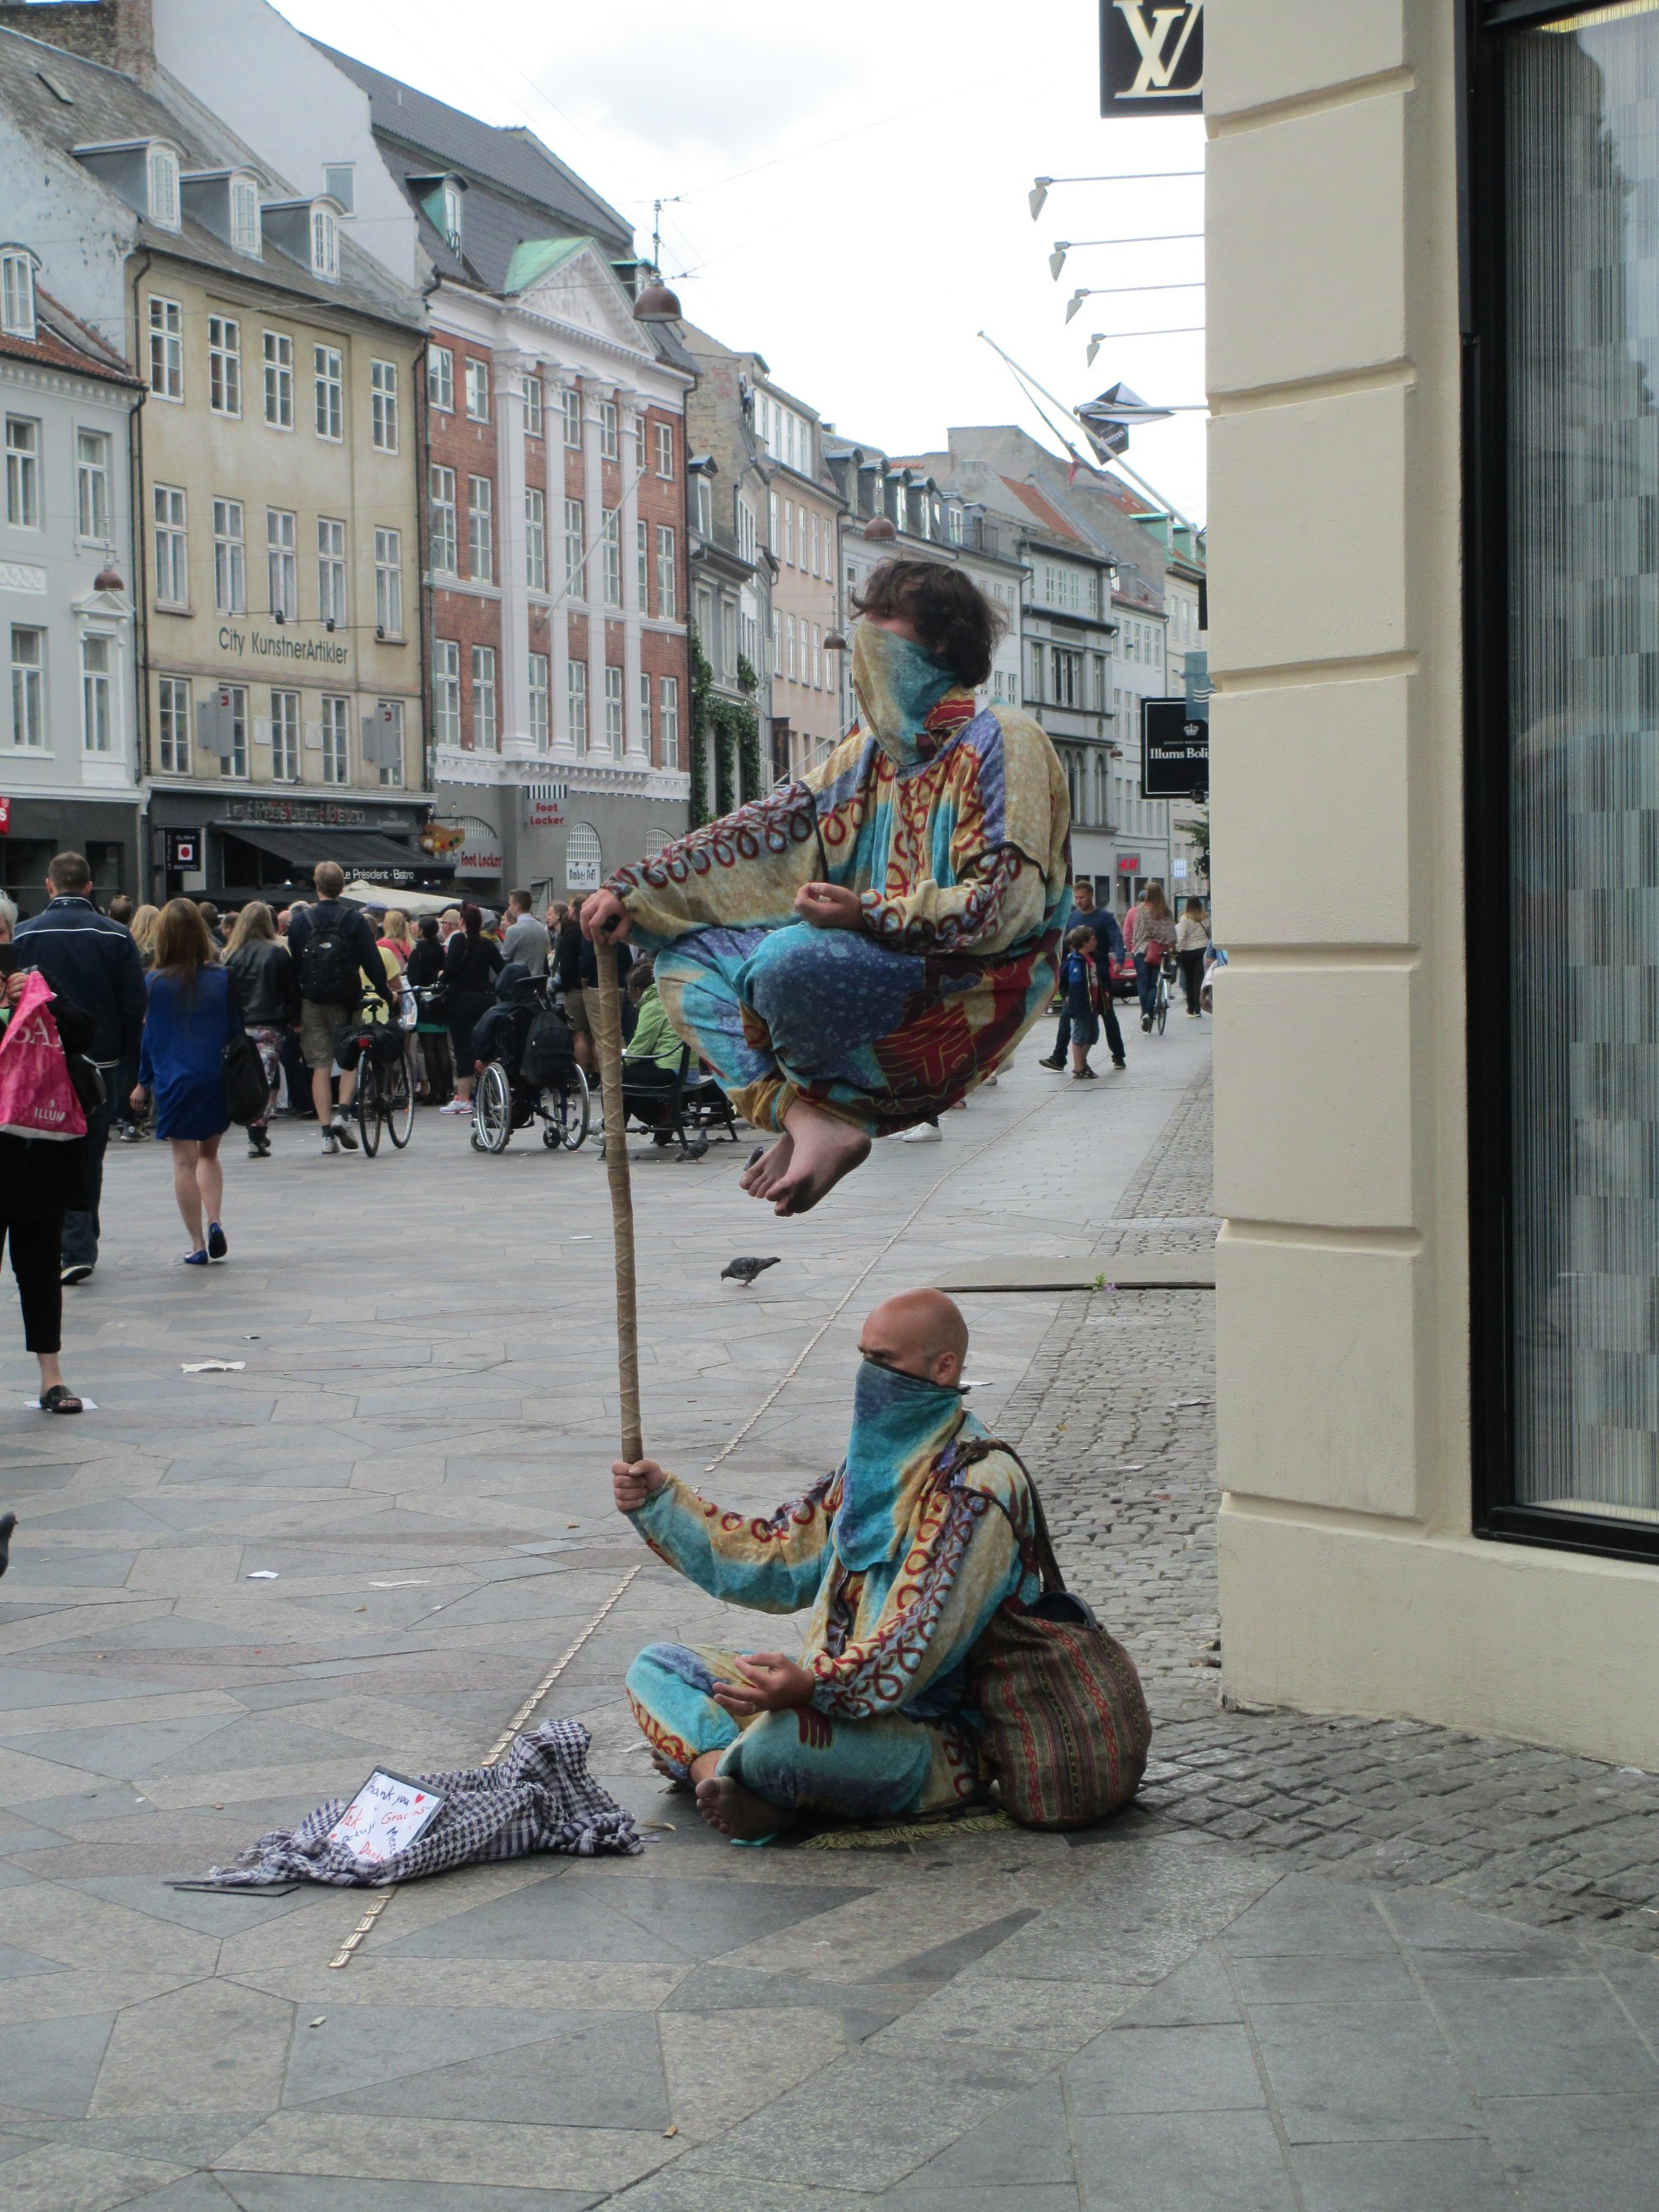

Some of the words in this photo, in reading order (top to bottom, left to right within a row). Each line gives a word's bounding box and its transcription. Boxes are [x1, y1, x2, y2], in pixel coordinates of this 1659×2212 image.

[219, 626, 246, 656] City
[251, 631, 348, 664] KunstnerArtikler
[1150, 748, 1185, 758] Illums
[535, 802, 558, 813] Foot
[529, 816, 565, 826] Locker
[460, 850, 477, 867] Foot
[479, 852, 503, 868] Locker
[353, 868, 389, 879] Président
[393, 869, 415, 880] Bistro
[35, 1107, 66, 1121] ILLUM
[365, 1774, 395, 1800] Thank
[392, 1795, 410, 1806] you
[339, 1805, 363, 1829] Tak
[381, 1806, 426, 1825] Gracias
